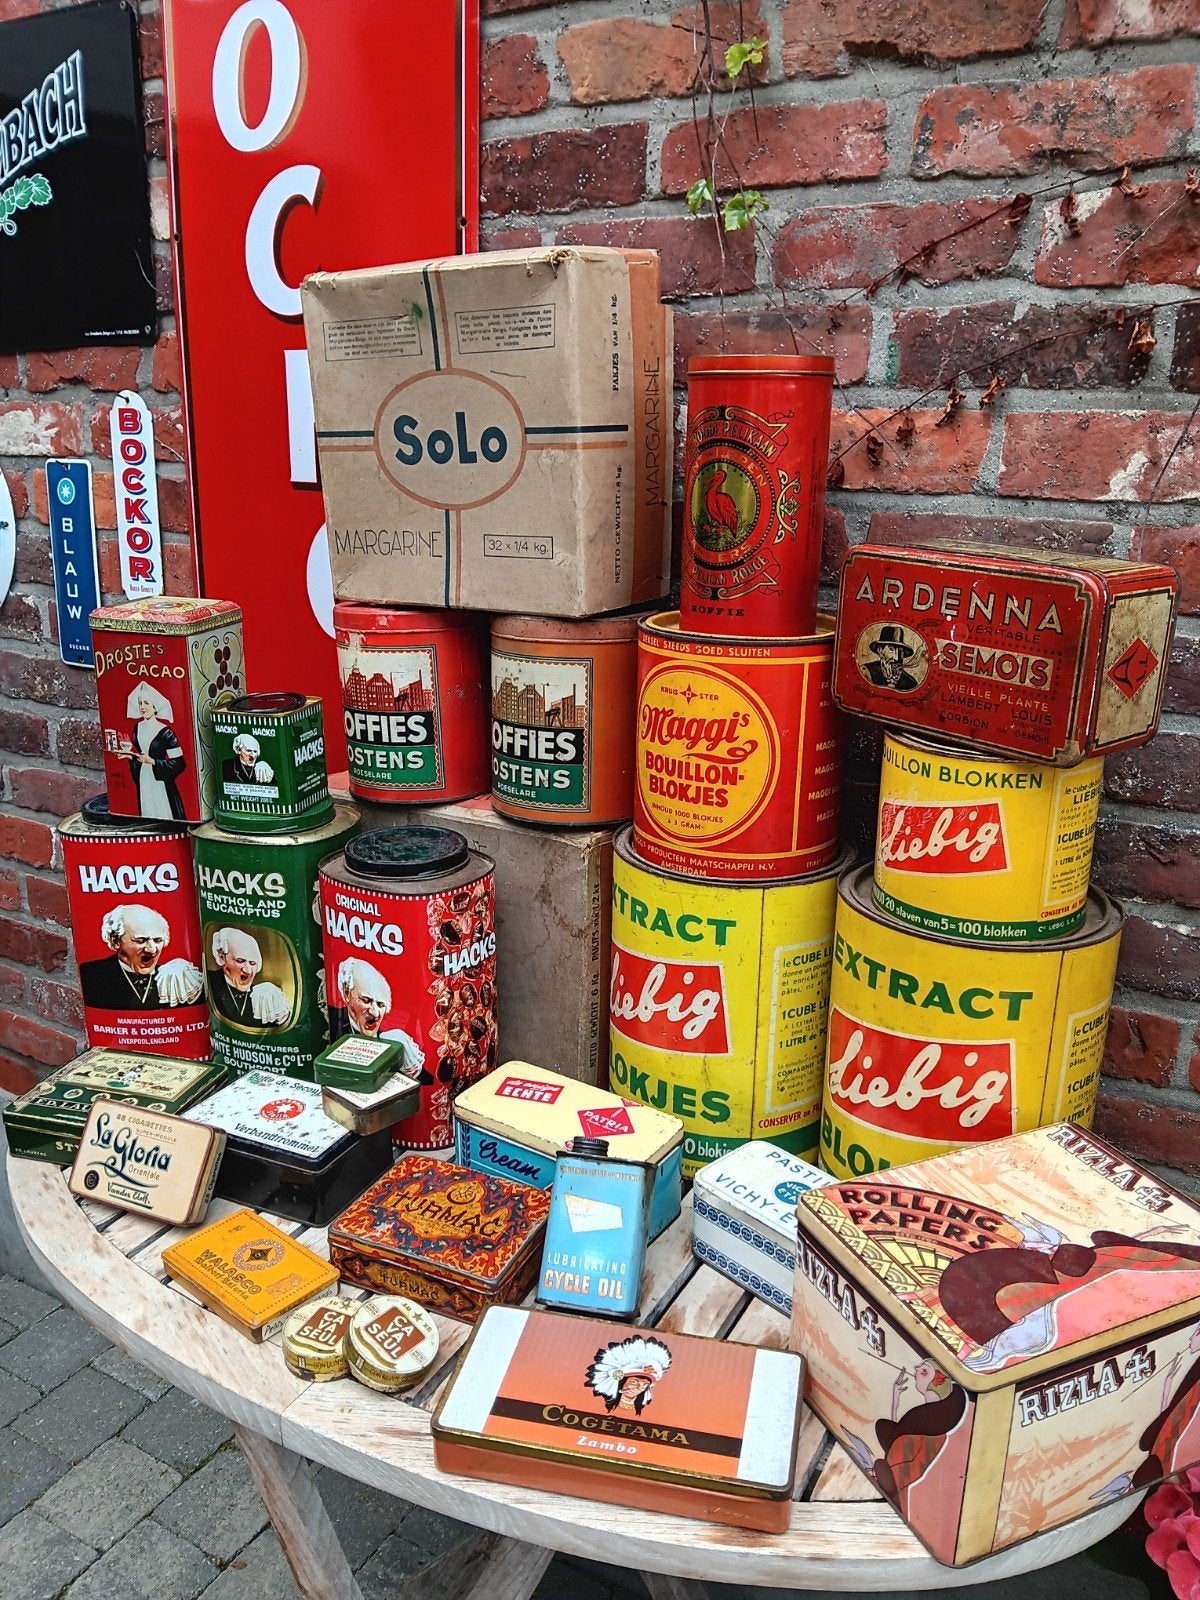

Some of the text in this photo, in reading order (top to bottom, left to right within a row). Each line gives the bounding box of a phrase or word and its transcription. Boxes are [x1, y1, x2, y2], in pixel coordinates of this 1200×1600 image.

[643, 356, 660, 506] MARGARINE
[118, 408, 156, 582] BOCKOR
[334, 529, 444, 559] MARGARINE
[488, 539, 503, 552] 32
[514, 539, 530, 553] 1/4
[61, 517, 82, 620] BLAUW
[731, 554, 769, 585] ROUGE
[691, 604, 745, 617] KOFFIE
[855, 573, 1064, 636] ARDENNA
[663, 640, 691, 653] STEEDS
[696, 646, 724, 656] GOED
[728, 647, 772, 658] SLUITEN
[95, 643, 164, 680] DROSTE'S
[126, 661, 186, 680] CACAO
[940, 642, 1050, 687] SEMOIS
[660, 686, 719, 701] KRUIS STER
[940, 692, 1000, 714] LAMBERT
[946, 682, 1050, 712] VIEILLE PLANTE
[939, 710, 989, 730] CORBION
[1011, 708, 1053, 726] LOUIS
[215, 724, 276, 738] HACKS HACKS
[294, 737, 324, 768] HACKS
[645, 749, 745, 786] BOUILLON-
[938, 766, 1043, 789] BLOKKEN
[649, 775, 729, 808] BLOKJES
[652, 802, 724, 824] INHOUD 1000 BLOKJES
[647, 844, 777, 872] PRODUCTEN MAATSCHAPPIJ N.V.
[660, 861, 707, 877] AMSTERDAM
[1060, 855, 1074, 866] LITRE
[79, 863, 180, 894] HACKS
[197, 864, 287, 897] HACKS
[200, 889, 287, 910] MENTHOL AND
[206, 901, 281, 919] EUCALYPTUS
[335, 892, 381, 917] ORIGINAL
[885, 898, 895, 912] 20
[895, 905, 921, 924] staven
[923, 917, 940, 930] van
[983, 925, 1027, 938] blokken
[1040, 906, 1070, 919] CONSERVER
[324, 905, 404, 956] HACKS
[443, 931, 496, 977] HACKS
[783, 953, 821, 968] le CUBE
[781, 973, 818, 987] et enrichit
[782, 967, 803, 978] donne
[835, 931, 1033, 1021] EXTRACT
[117, 1016, 176, 1025] MANUFACTURED BY
[786, 1003, 817, 1019] CUBE
[93, 1024, 129, 1036] BARKER
[130, 1026, 139, 1036] &
[140, 1024, 184, 1036] DOBSON
[590, 988, 599, 1068] NETTO GEWICHT 6
[1073, 1014, 1105, 1037] le CUBE
[214, 1032, 300, 1054] SOLE MANUFACTURERS
[785, 1033, 817, 1049] LITRE de
[233, 1046, 274, 1066] HUDSON
[777, 1061, 814, 1078] COMPAGNIE
[276, 1079, 290, 1087] de
[501, 1086, 553, 1102] ECHTE
[583, 1111, 629, 1133] PATRIA
[758, 1110, 801, 1129] CONSERVER
[90, 1112, 172, 1174] La Gloria
[479, 1138, 541, 1181] Cream
[128, 1164, 160, 1181] Orientale
[391, 1190, 503, 1238] TURMAC
[839, 1189, 1004, 1233] ROLLING
[849, 1207, 996, 1251] PAPERS
[200, 1248, 262, 1295] WALASCO
[547, 1254, 627, 1275] LUBRICATING
[543, 1268, 625, 1301] CYCLE OIL
[318, 1320, 336, 1334] VA
[323, 1311, 345, 1325] CA
[393, 1315, 415, 1338] CA
[300, 1325, 339, 1346] SEUL
[367, 1322, 403, 1359] SEUL
[386, 1321, 404, 1343] VA
[576, 1435, 638, 1455] Zambo
